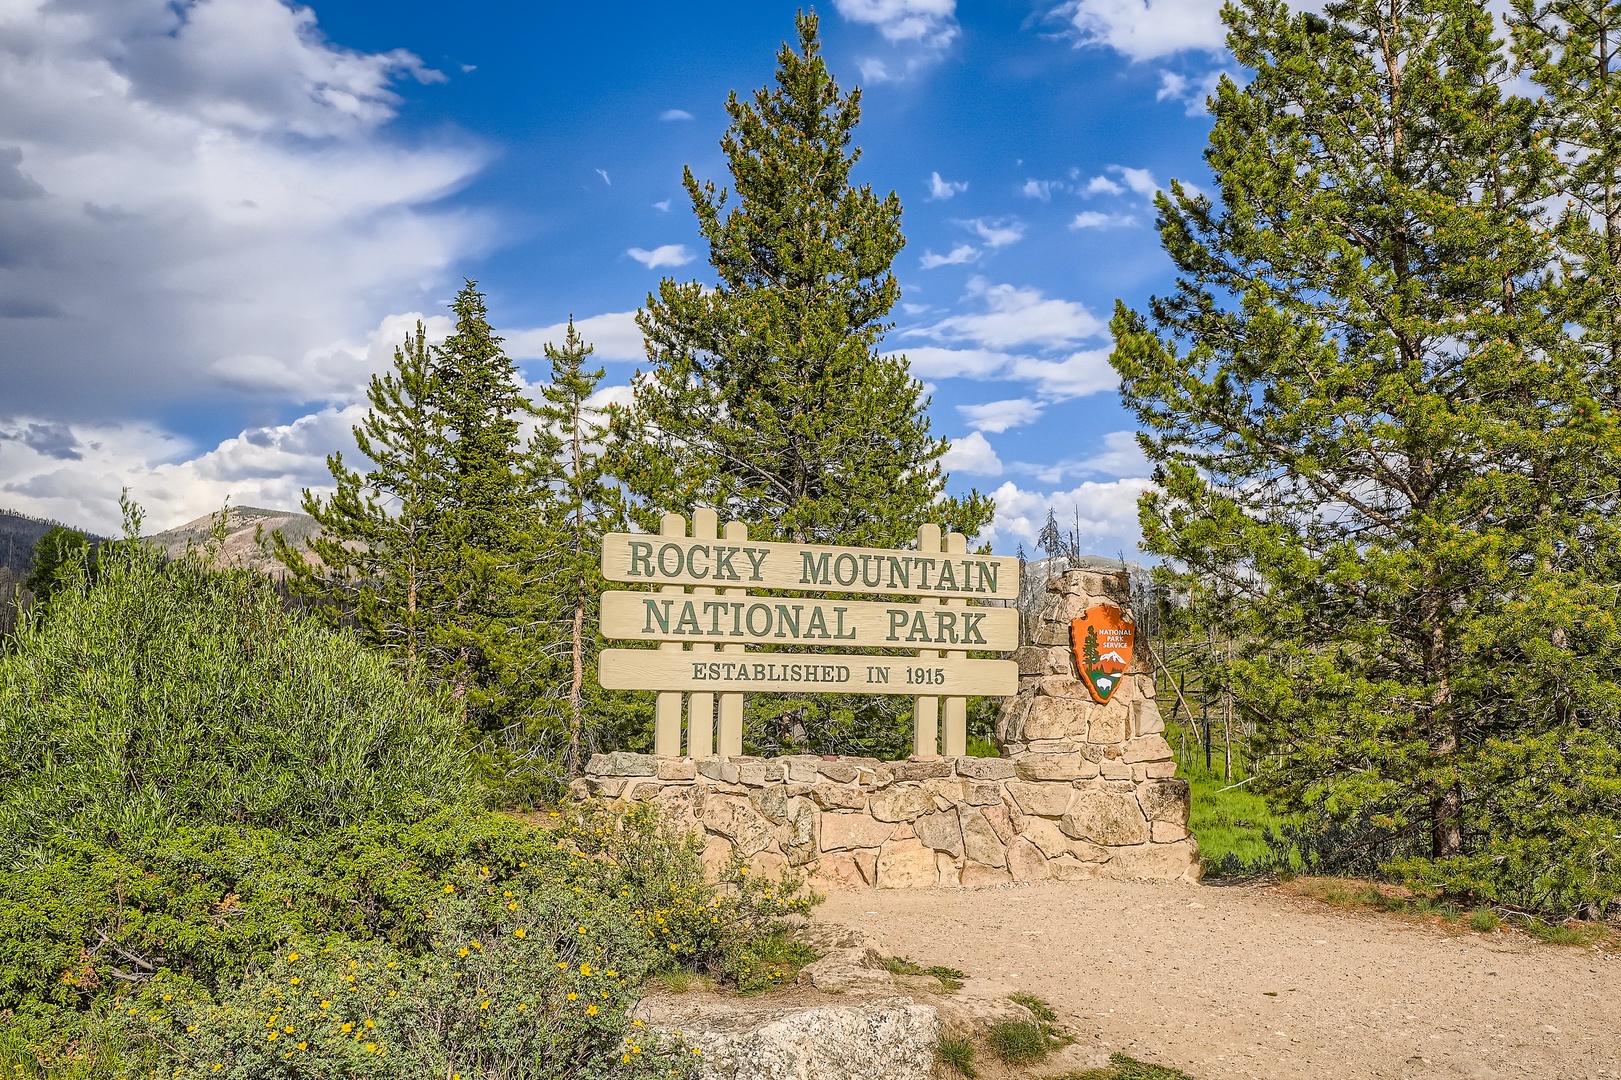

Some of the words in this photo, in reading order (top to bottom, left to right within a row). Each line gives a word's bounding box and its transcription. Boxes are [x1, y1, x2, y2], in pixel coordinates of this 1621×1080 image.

[627, 541, 770, 581] ROCKY
[799, 551, 1000, 593] MOUNTAIN
[642, 599, 856, 640] NATIONAL
[886, 609, 987, 645] PARK
[692, 662, 850, 683] ESTABLISHED
[866, 666, 891, 684] IN
[906, 667, 945, 685] 1915
